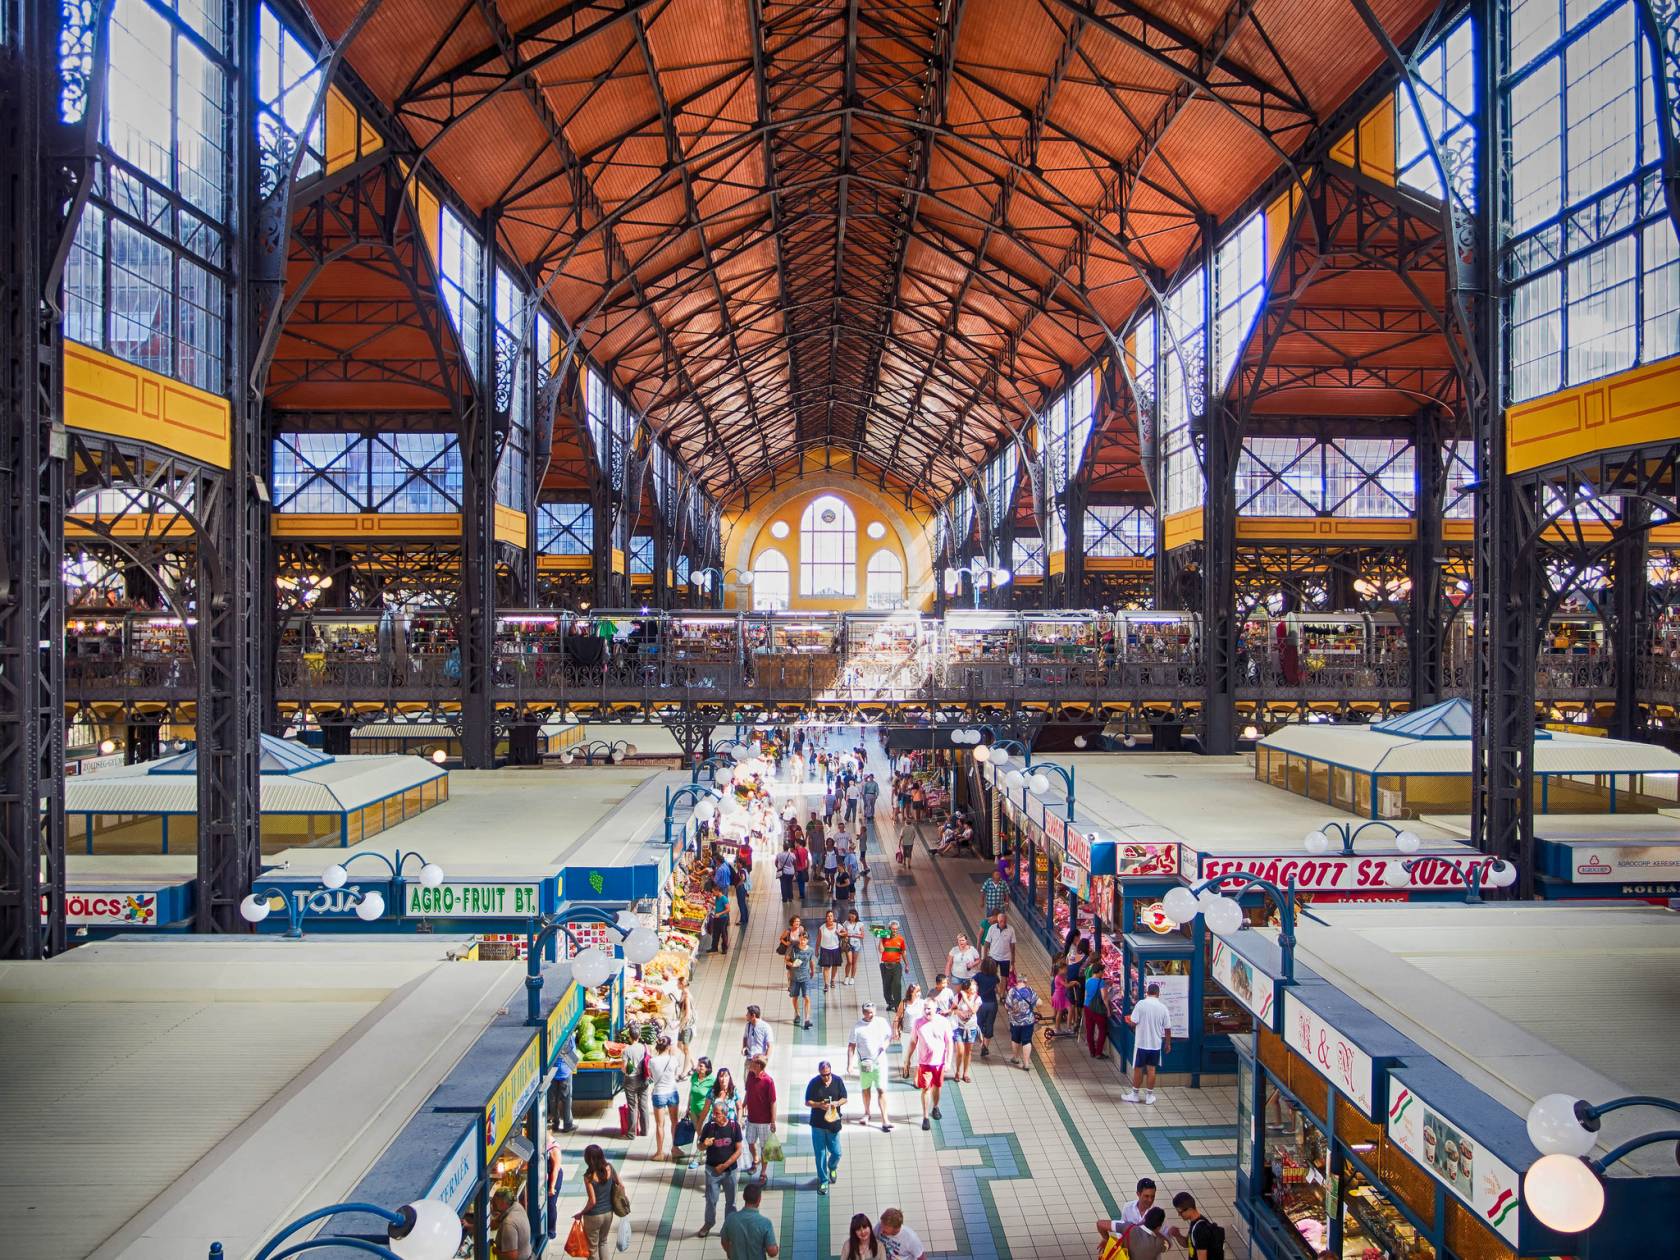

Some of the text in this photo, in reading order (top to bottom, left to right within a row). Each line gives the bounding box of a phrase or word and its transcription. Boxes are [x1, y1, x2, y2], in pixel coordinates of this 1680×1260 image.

[1206, 858, 1348, 887] FELVÁGOTT
[410, 886, 506, 913] AGRO-FRUIT
[1317, 1028, 1331, 1070] &
